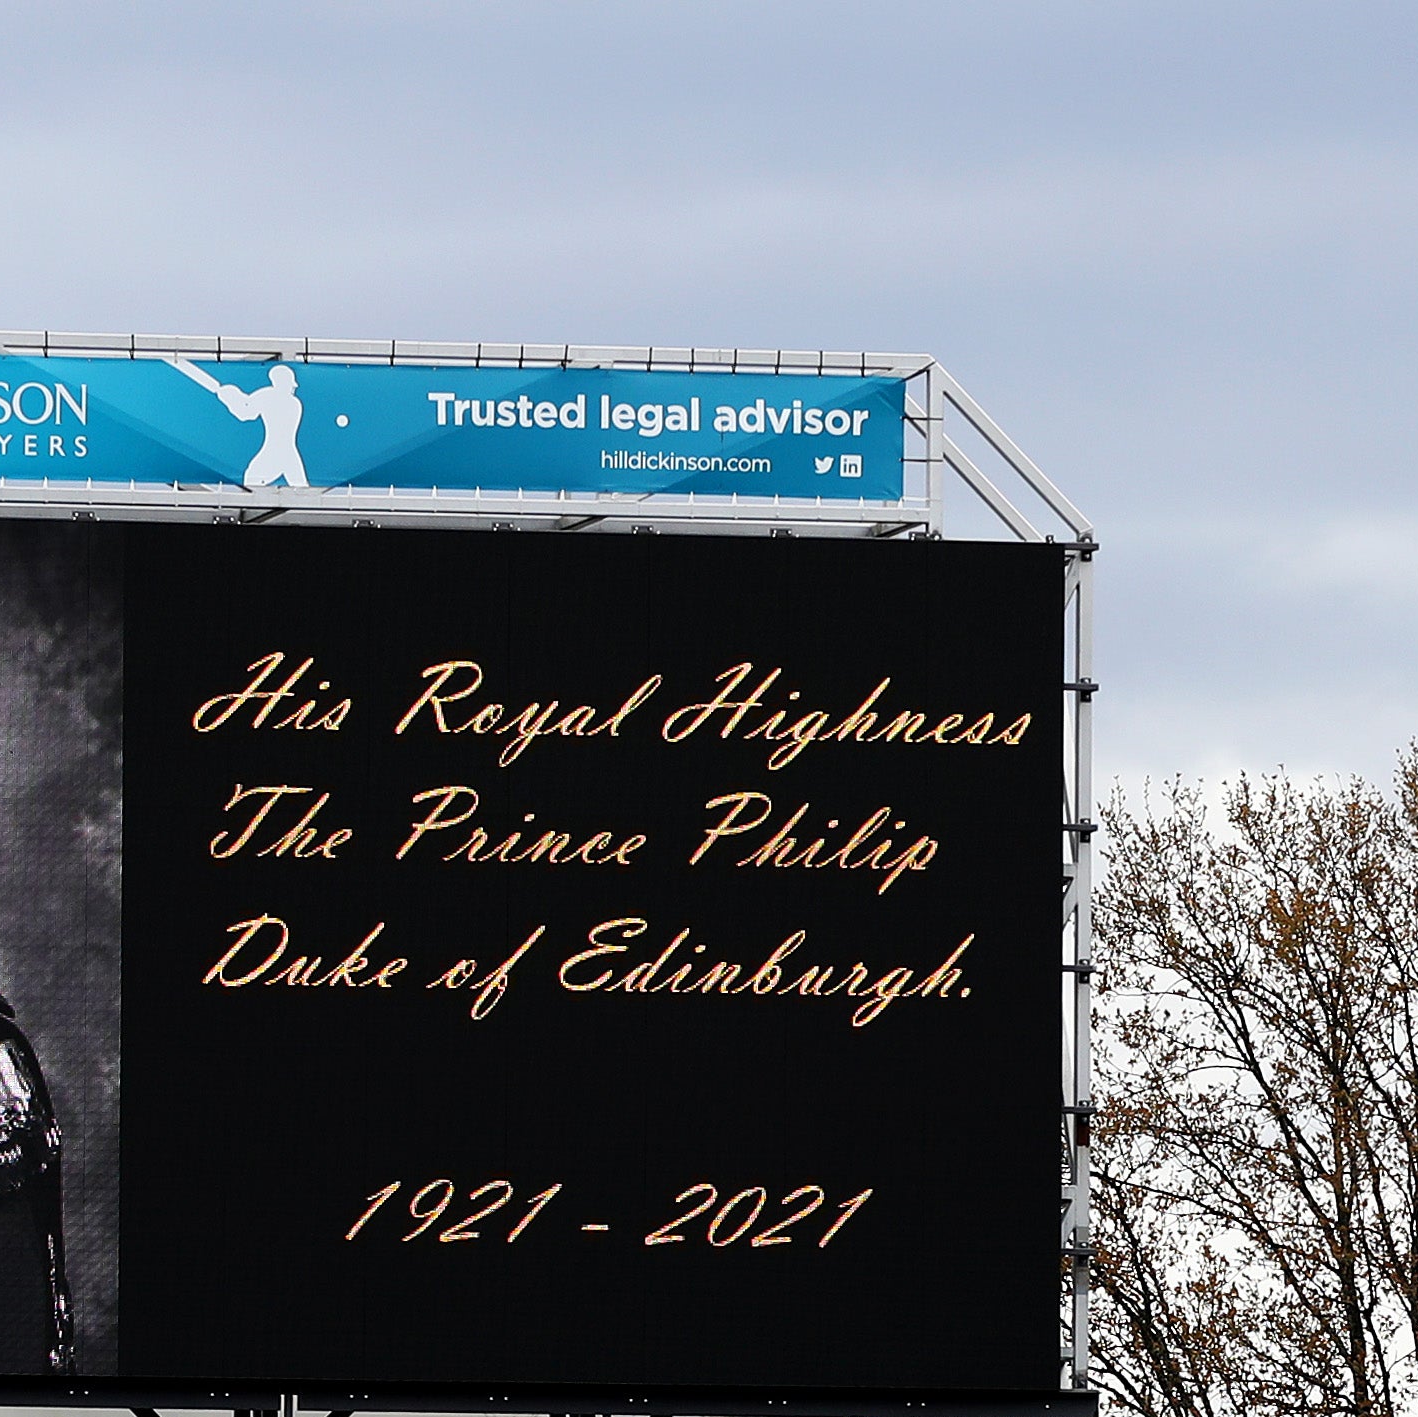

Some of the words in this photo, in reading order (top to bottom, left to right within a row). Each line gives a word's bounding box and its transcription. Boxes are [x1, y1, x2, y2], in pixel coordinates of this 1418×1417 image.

[428, 392, 586, 429] Trusted
[601, 395, 700, 437] legal
[714, 399, 870, 436] advisor
[601, 450, 771, 473] hilldickinson.com
[193, 651, 351, 733] His
[395, 660, 663, 768] Royal
[661, 662, 1032, 771] Highness
[210, 783, 353, 859] The
[396, 785, 647, 865] Prince
[690, 791, 939, 896] Philip
[202, 912, 408, 988] Duke
[426, 925, 546, 1021] of
[558, 917, 975, 1027] Edinburgh.
[344, 1179, 563, 1243] 1921
[645, 1183, 873, 1249] 2021
